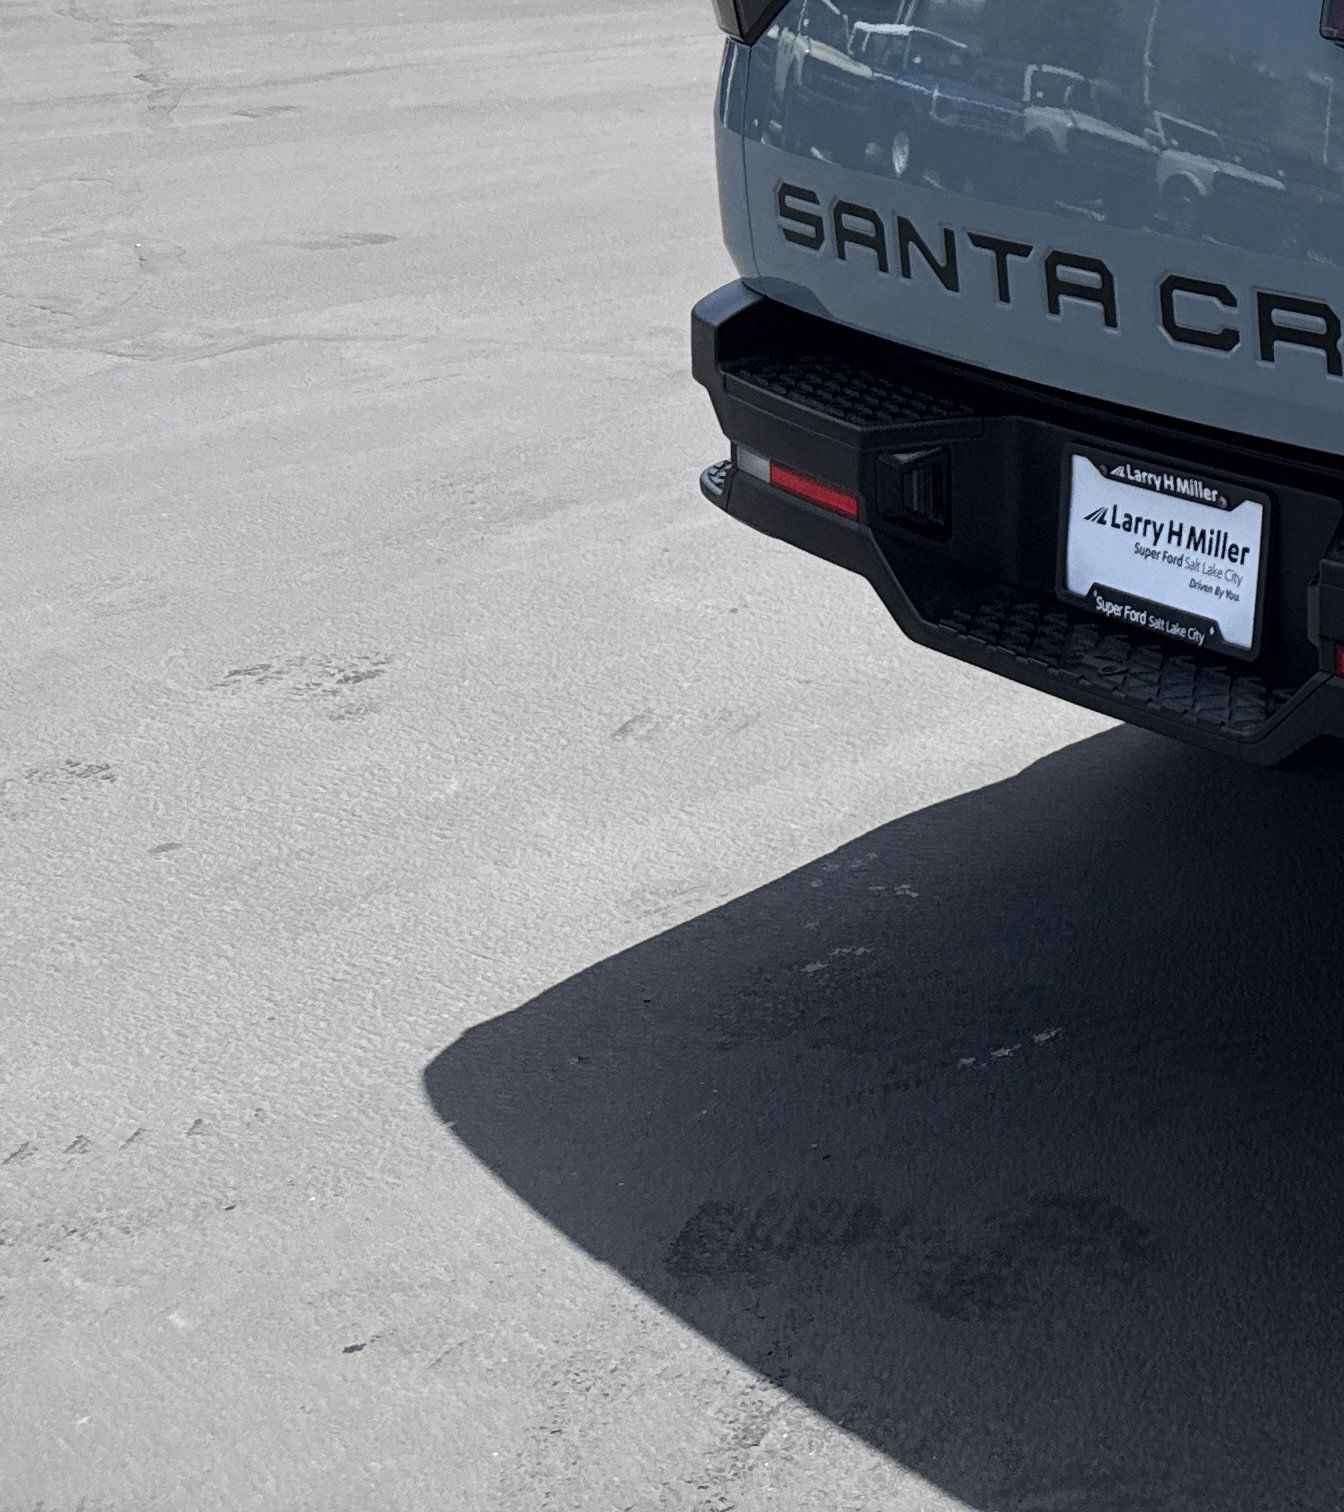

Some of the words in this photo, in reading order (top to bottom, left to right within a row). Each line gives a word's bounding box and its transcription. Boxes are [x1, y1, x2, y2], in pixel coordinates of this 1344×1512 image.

[776, 182, 1119, 329] SANTA
[1126, 464, 1162, 491] Larry
[1164, 473, 1175, 491] H
[1176, 477, 1219, 503] Miller
[1110, 504, 1164, 546] Larry
[1168, 519, 1184, 547] H
[1186, 525, 1250, 566] Miller
[1133, 542, 1160, 562] Super
[1162, 549, 1184, 568] Ford
[1184, 556, 1201, 574] Salt
[1202, 562, 1224, 580] Lake
[1224, 568, 1244, 588] City
[1095, 596, 1125, 617] Super
[1124, 604, 1147, 625] Ford
[1148, 615, 1165, 630] Salt
[1166, 620, 1187, 638] Lake
[1187, 626, 1206, 646] City
